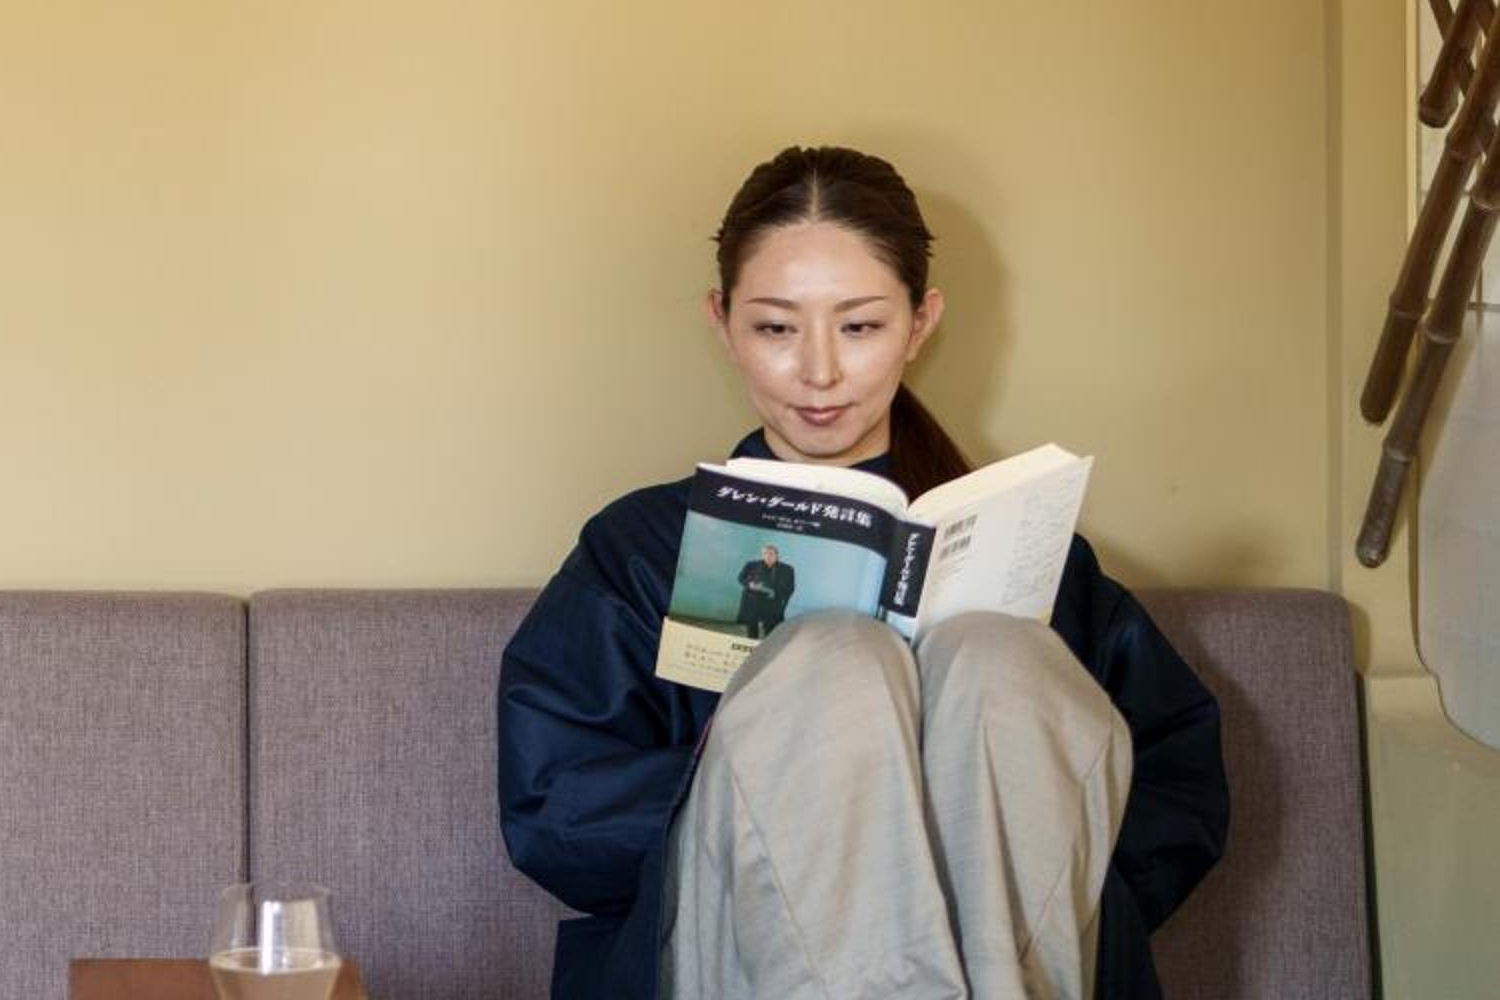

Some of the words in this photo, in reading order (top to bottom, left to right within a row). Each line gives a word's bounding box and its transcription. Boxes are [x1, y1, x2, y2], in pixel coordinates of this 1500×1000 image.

[716, 486, 872, 528] グレン・グールド発言集
